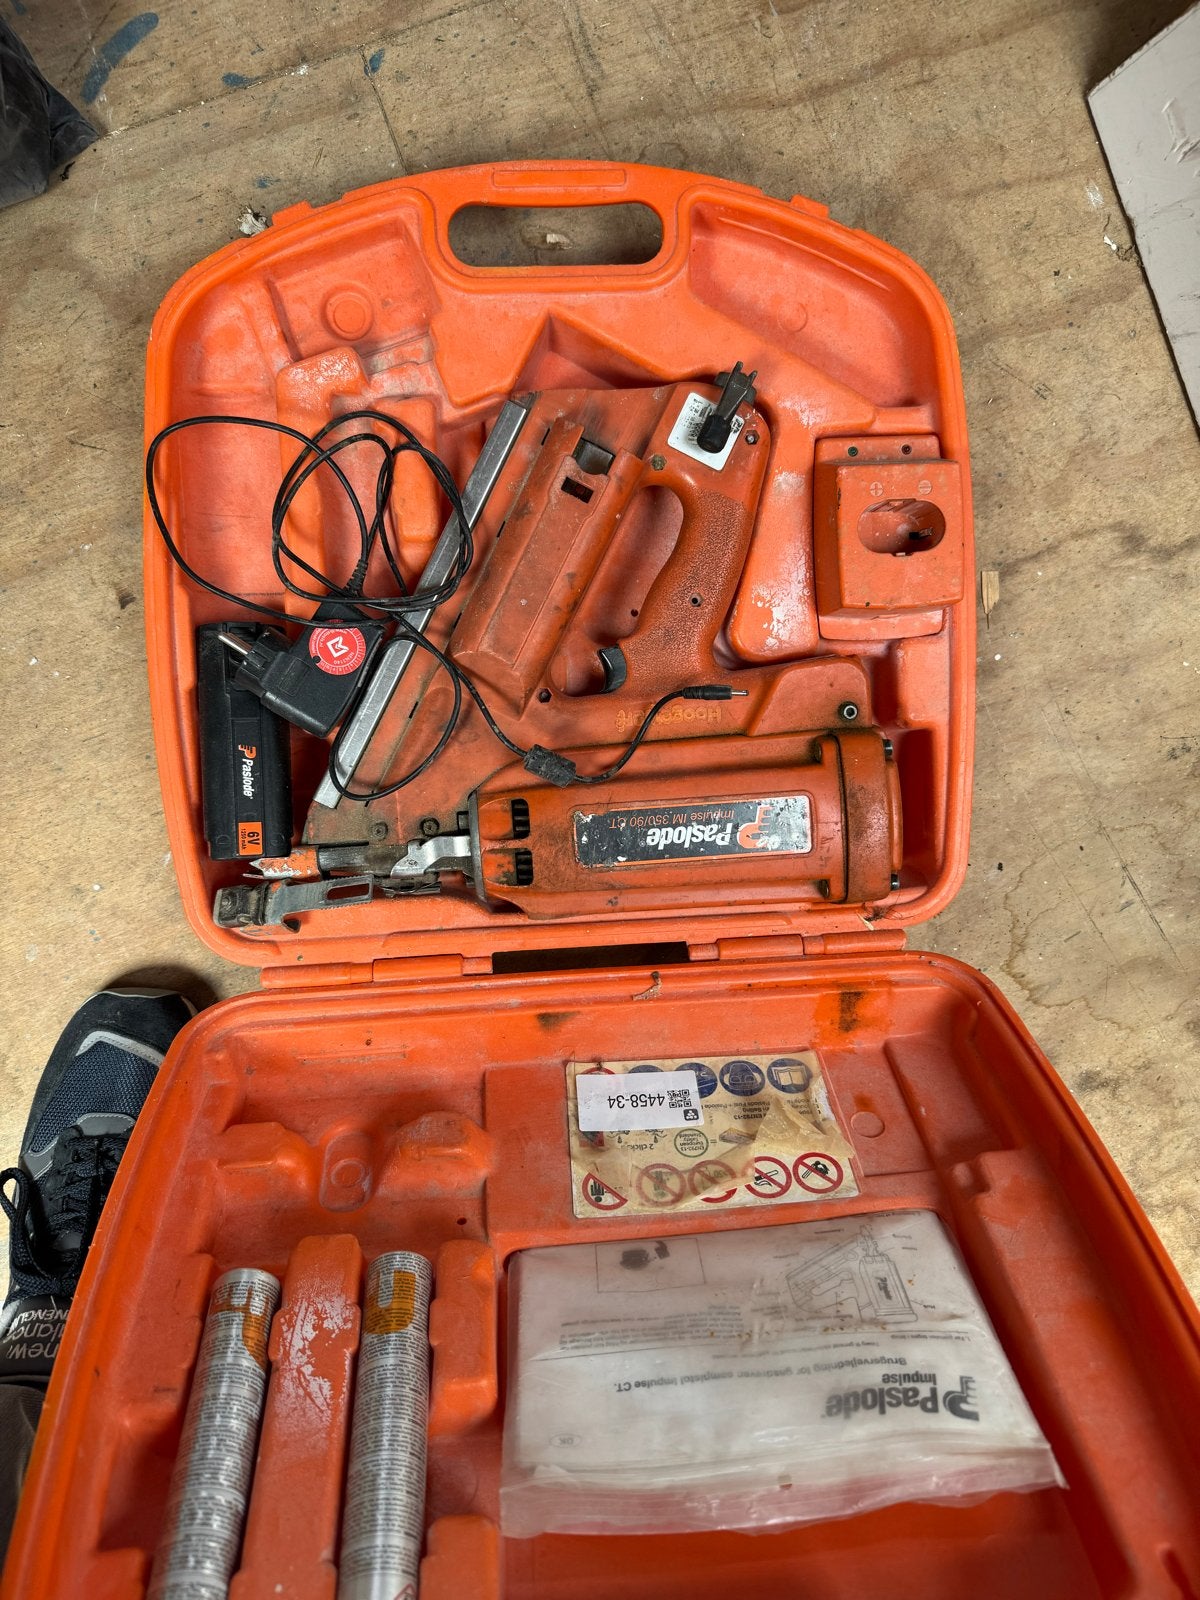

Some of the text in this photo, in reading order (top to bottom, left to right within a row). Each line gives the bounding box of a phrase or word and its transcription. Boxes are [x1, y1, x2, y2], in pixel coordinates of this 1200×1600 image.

[242, 758, 255, 797] Paslode
[609, 809, 735, 828] Impulse IM 350/90 CT
[247, 831, 260, 845] 6V
[646, 823, 733, 850] Paslode
[607, 1093, 666, 1109] 4458-34
[10, 1342, 59, 1359] new
[634, 1376, 678, 1389] Impulse
[882, 1370, 937, 1385] Impulse
[614, 1381, 632, 1393] CT.
[825, 1386, 939, 1420] Paslode
